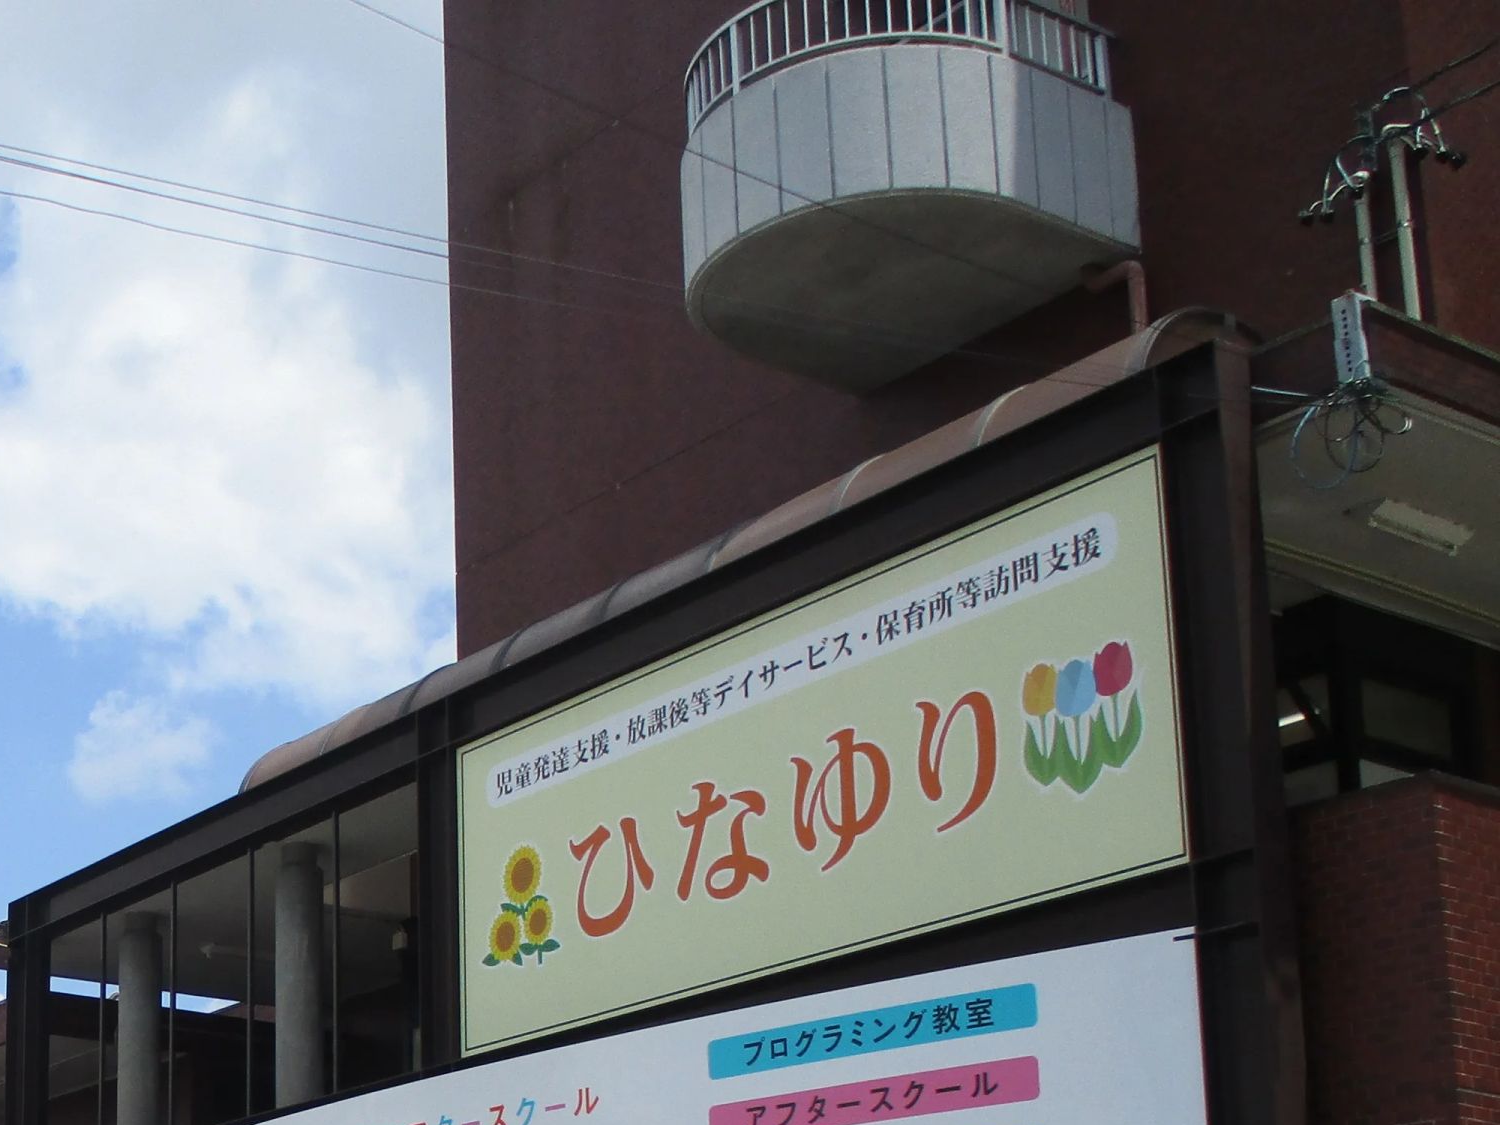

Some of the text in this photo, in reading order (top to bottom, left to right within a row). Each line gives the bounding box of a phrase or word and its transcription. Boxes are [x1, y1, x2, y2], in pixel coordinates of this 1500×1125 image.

[496, 527, 1102, 798] 児童発達支援・放課後等デイサービス・保育所等訪問支援
[569, 691, 997, 938] ひなゆり
[743, 998, 995, 1067] プログラミング教室
